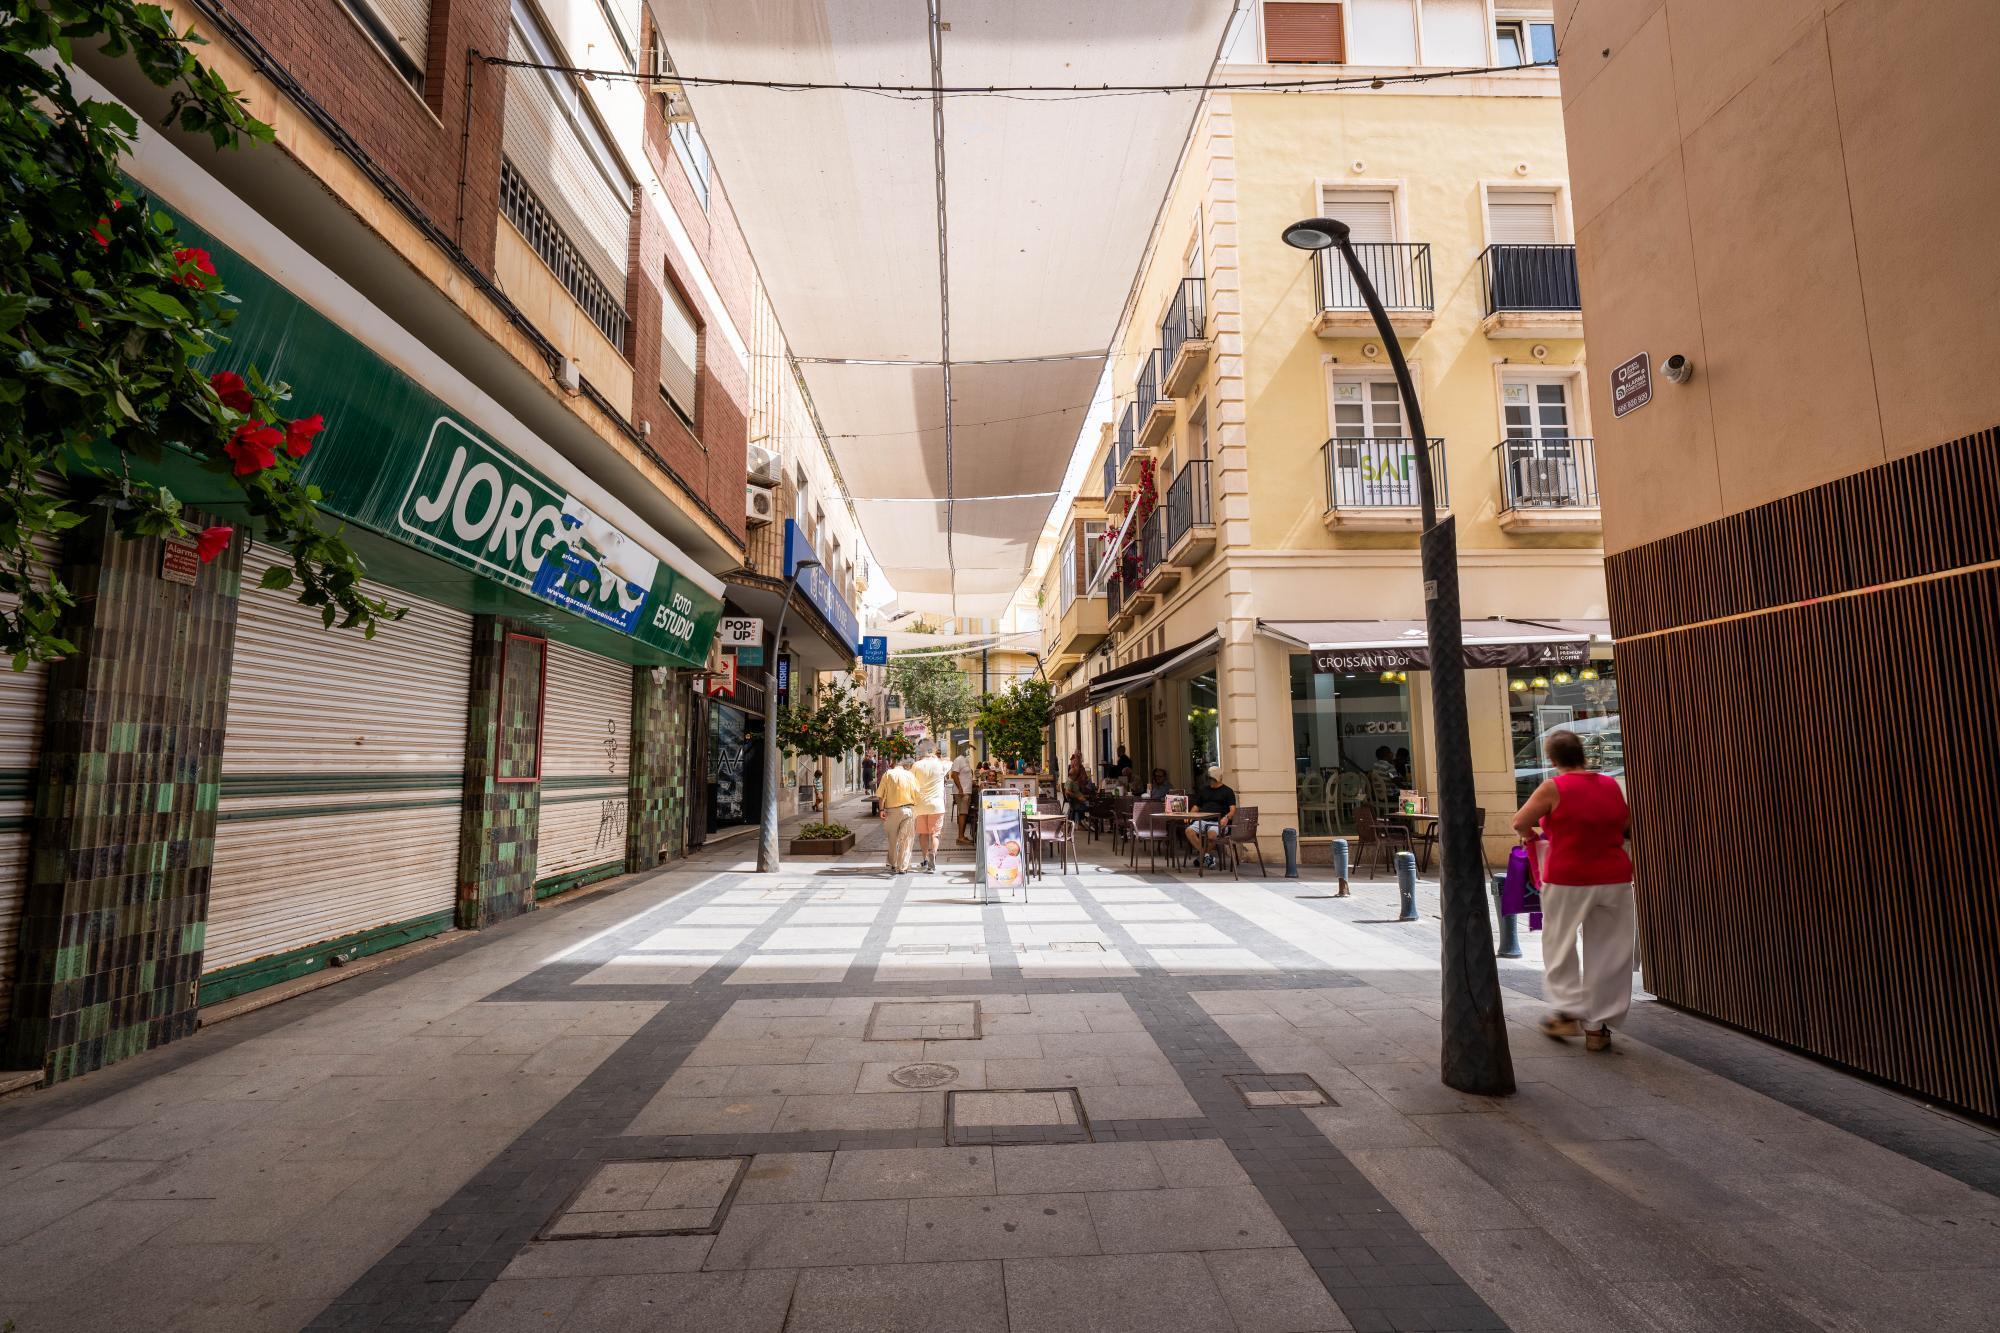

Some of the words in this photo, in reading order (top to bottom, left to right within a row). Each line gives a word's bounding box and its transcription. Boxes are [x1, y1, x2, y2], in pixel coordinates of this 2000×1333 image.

[416, 446, 564, 573] JORG
[168, 543, 198, 559] Alarma
[672, 592, 692, 616] FOTO
[652, 604, 695, 641] ESTUDIO
[725, 620, 752, 630] POP
[733, 631, 751, 641] UP
[1318, 655, 1385, 668] CROISSANT
[1387, 655, 1411, 666] D'or
